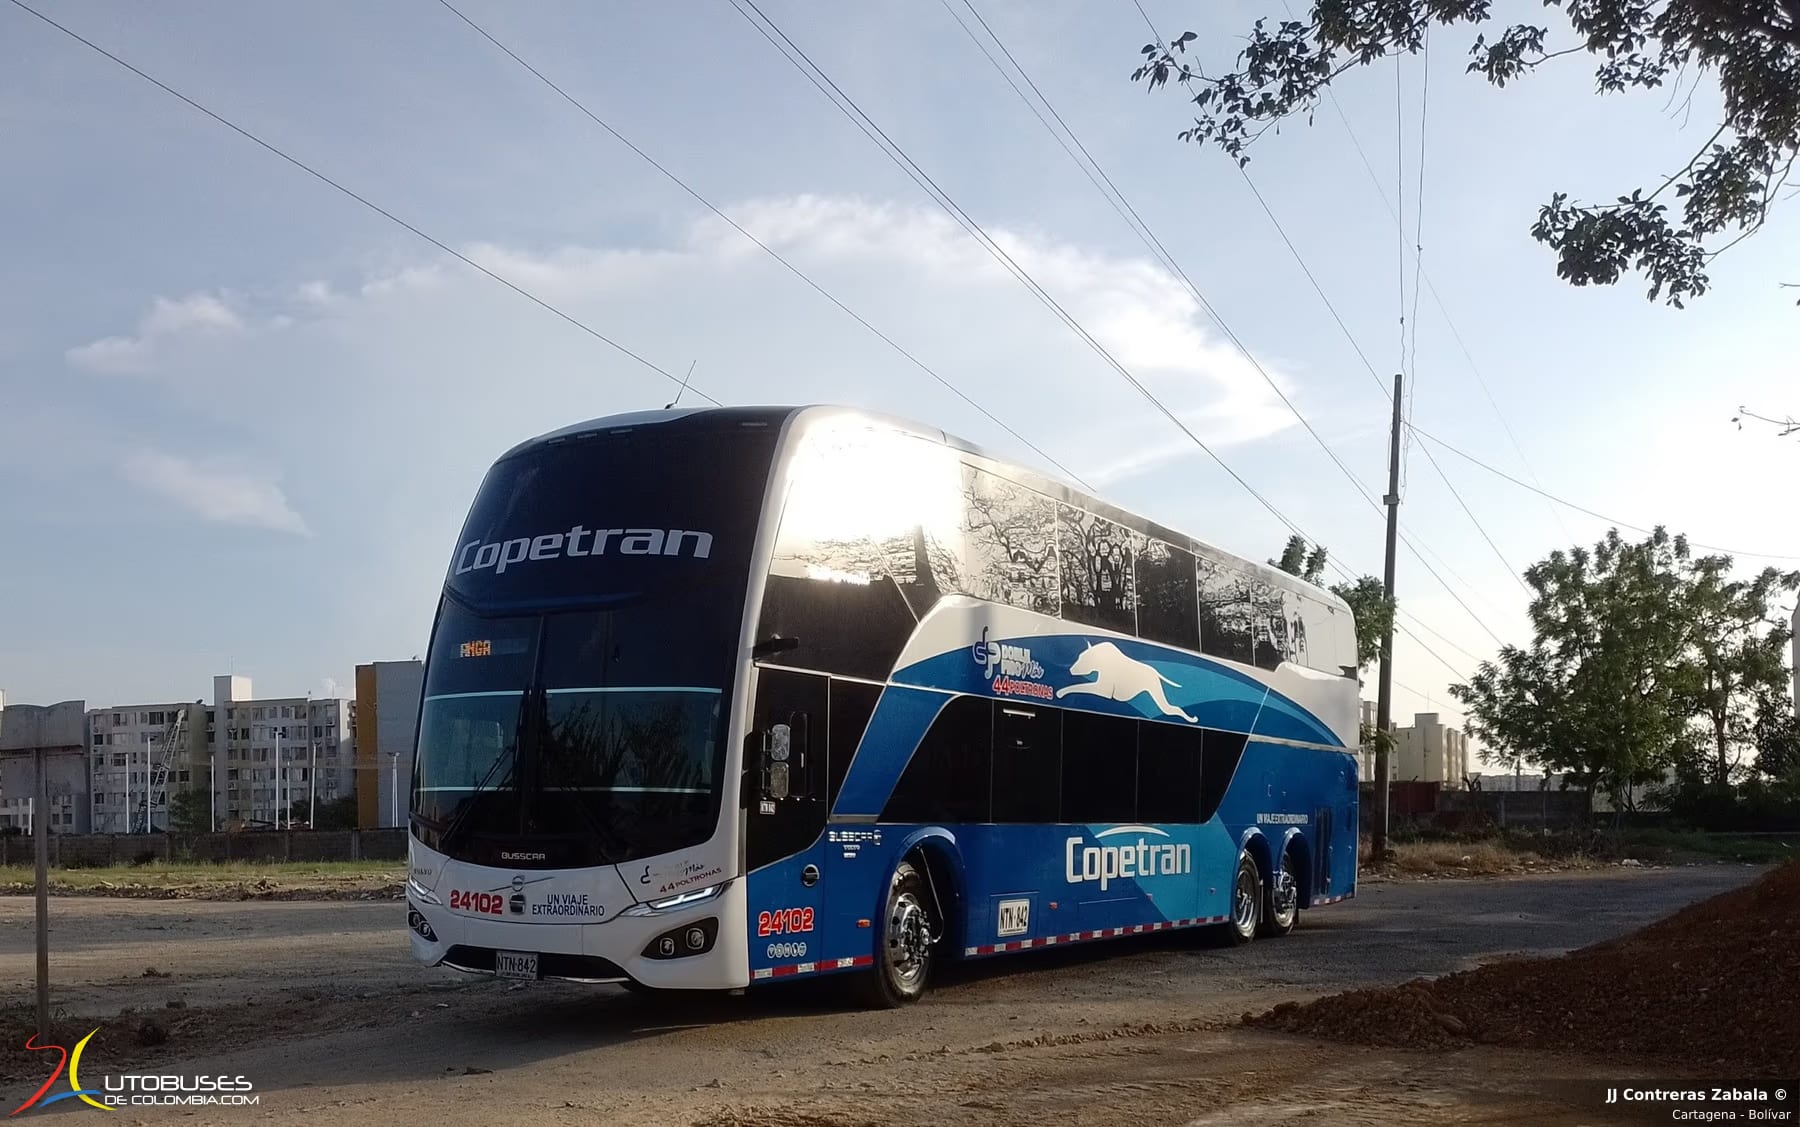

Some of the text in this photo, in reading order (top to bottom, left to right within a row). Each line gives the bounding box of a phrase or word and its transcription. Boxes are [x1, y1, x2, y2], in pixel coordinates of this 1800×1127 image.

[455, 524, 713, 575] Copetran
[992, 674, 1010, 696] 44
[501, 851, 546, 861] BUSSCAR
[1066, 836, 1191, 891] Copetran
[659, 867, 722, 893] 44 POLTRONAS
[450, 889, 503, 915] 24102
[532, 904, 605, 917] EXTRAORDINARIO
[547, 894, 588, 905] UN VIAJE
[758, 907, 815, 937] 24102
